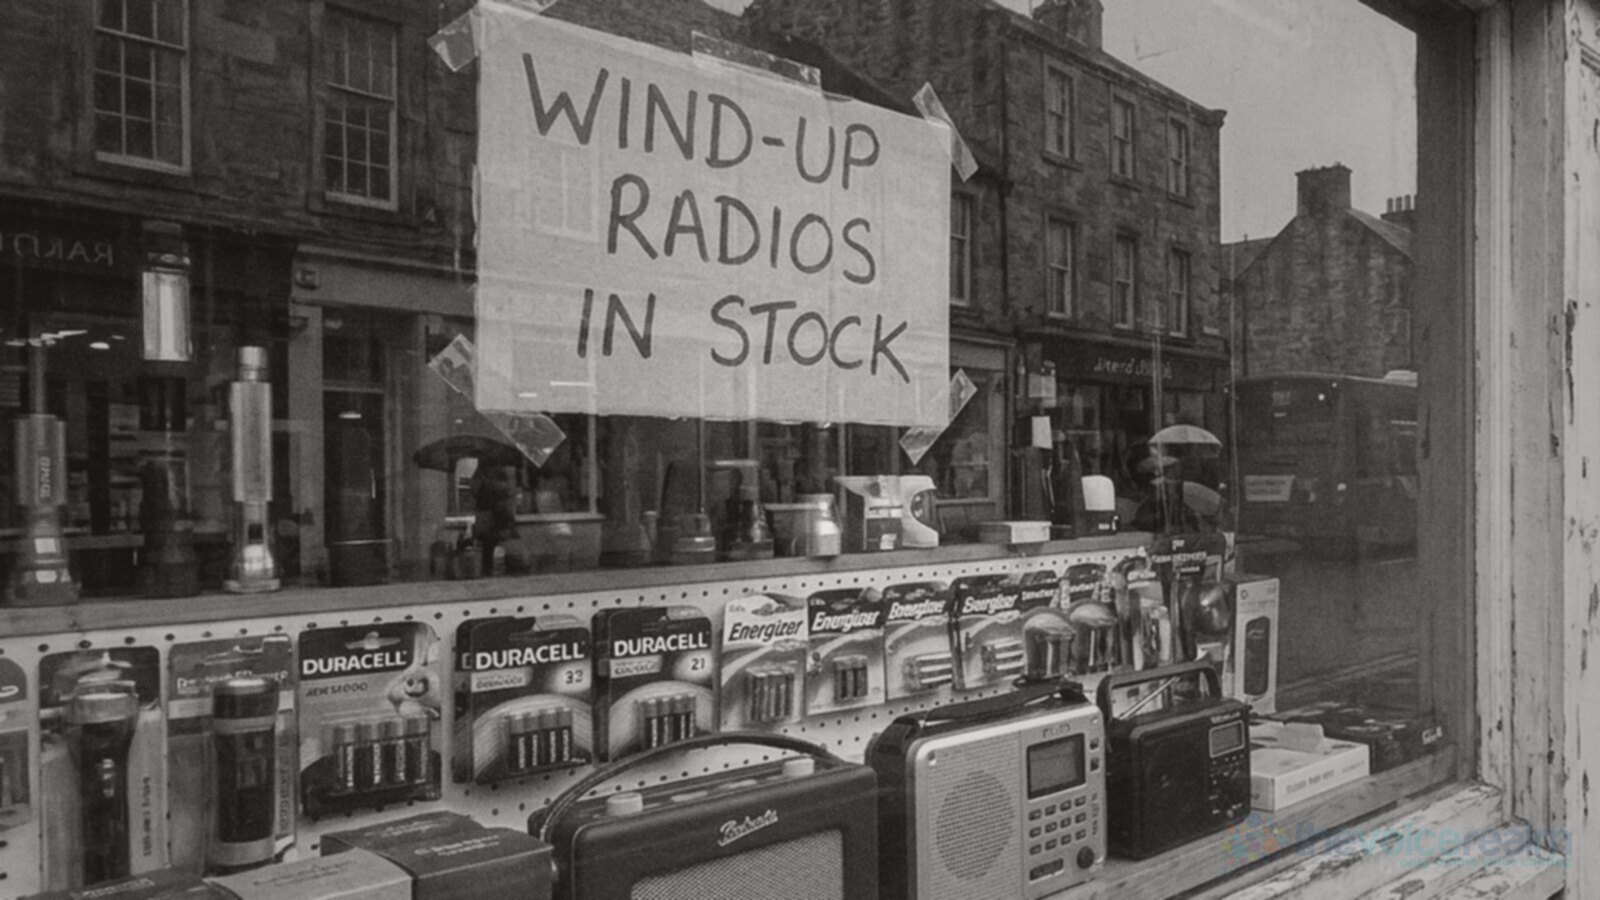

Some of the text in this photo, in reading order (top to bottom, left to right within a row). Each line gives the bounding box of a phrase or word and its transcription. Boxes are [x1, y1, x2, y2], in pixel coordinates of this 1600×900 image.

[522, 52, 880, 190] WIND-UP
[607, 173, 876, 285] RADIOS
[577, 288, 910, 383] IN STOCK
[475, 642, 585, 671] DURACELL
[613, 632, 708, 657] DURACELL
[302, 651, 407, 675] DURACELL
[691, 658, 706, 671] 21
